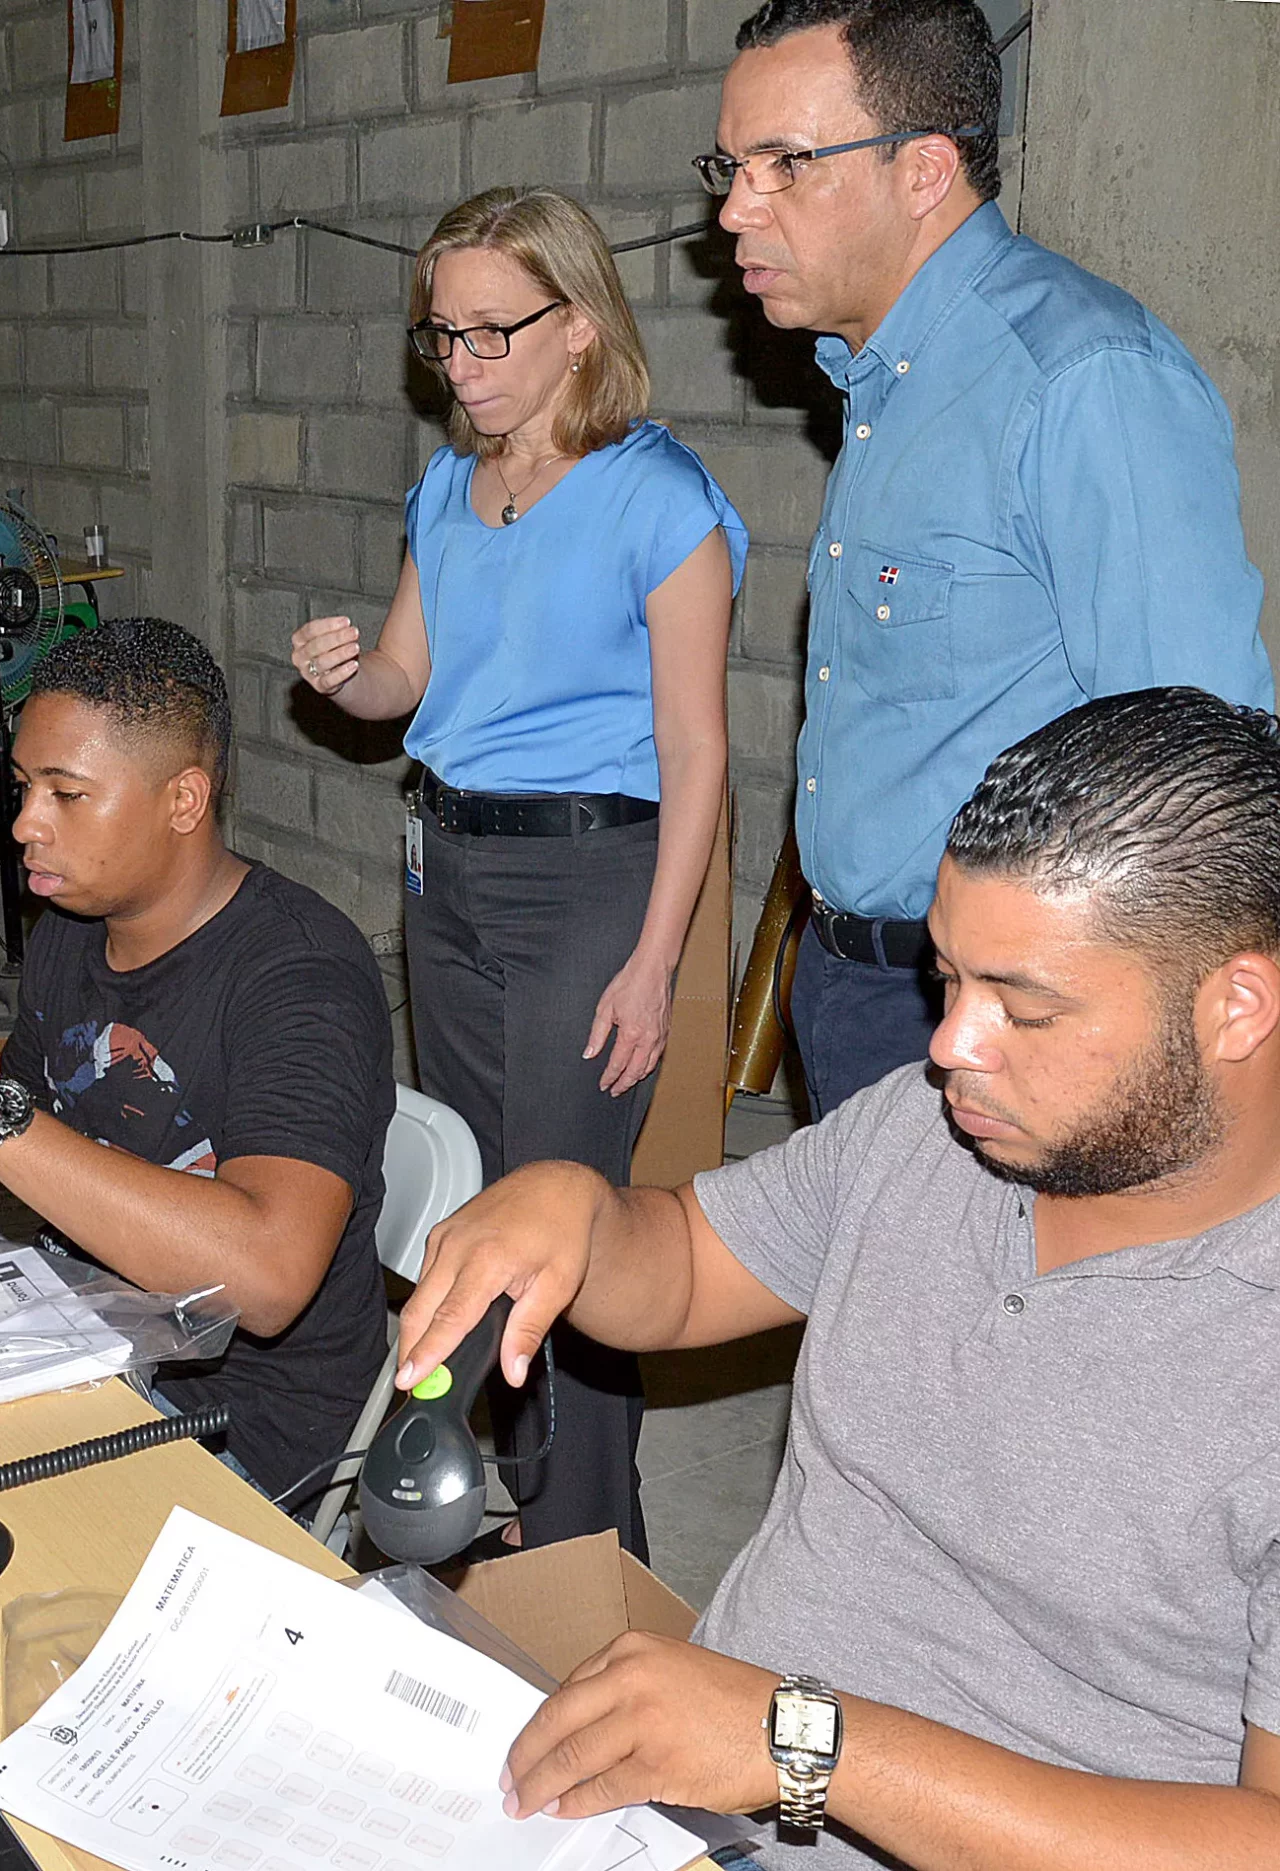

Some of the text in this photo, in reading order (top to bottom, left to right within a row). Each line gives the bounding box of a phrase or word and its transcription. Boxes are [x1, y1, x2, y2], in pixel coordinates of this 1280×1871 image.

[6, 1281, 31, 1303] Forma
[155, 1545, 196, 1612] MATEMATICA
[284, 1627, 305, 1646] 4
[121, 1678, 146, 1708] MATUTINA
[92, 1753, 118, 1779] GISELLE
[114, 1730, 140, 1755] PAMELA
[136, 1699, 165, 1730] CASTILLO
